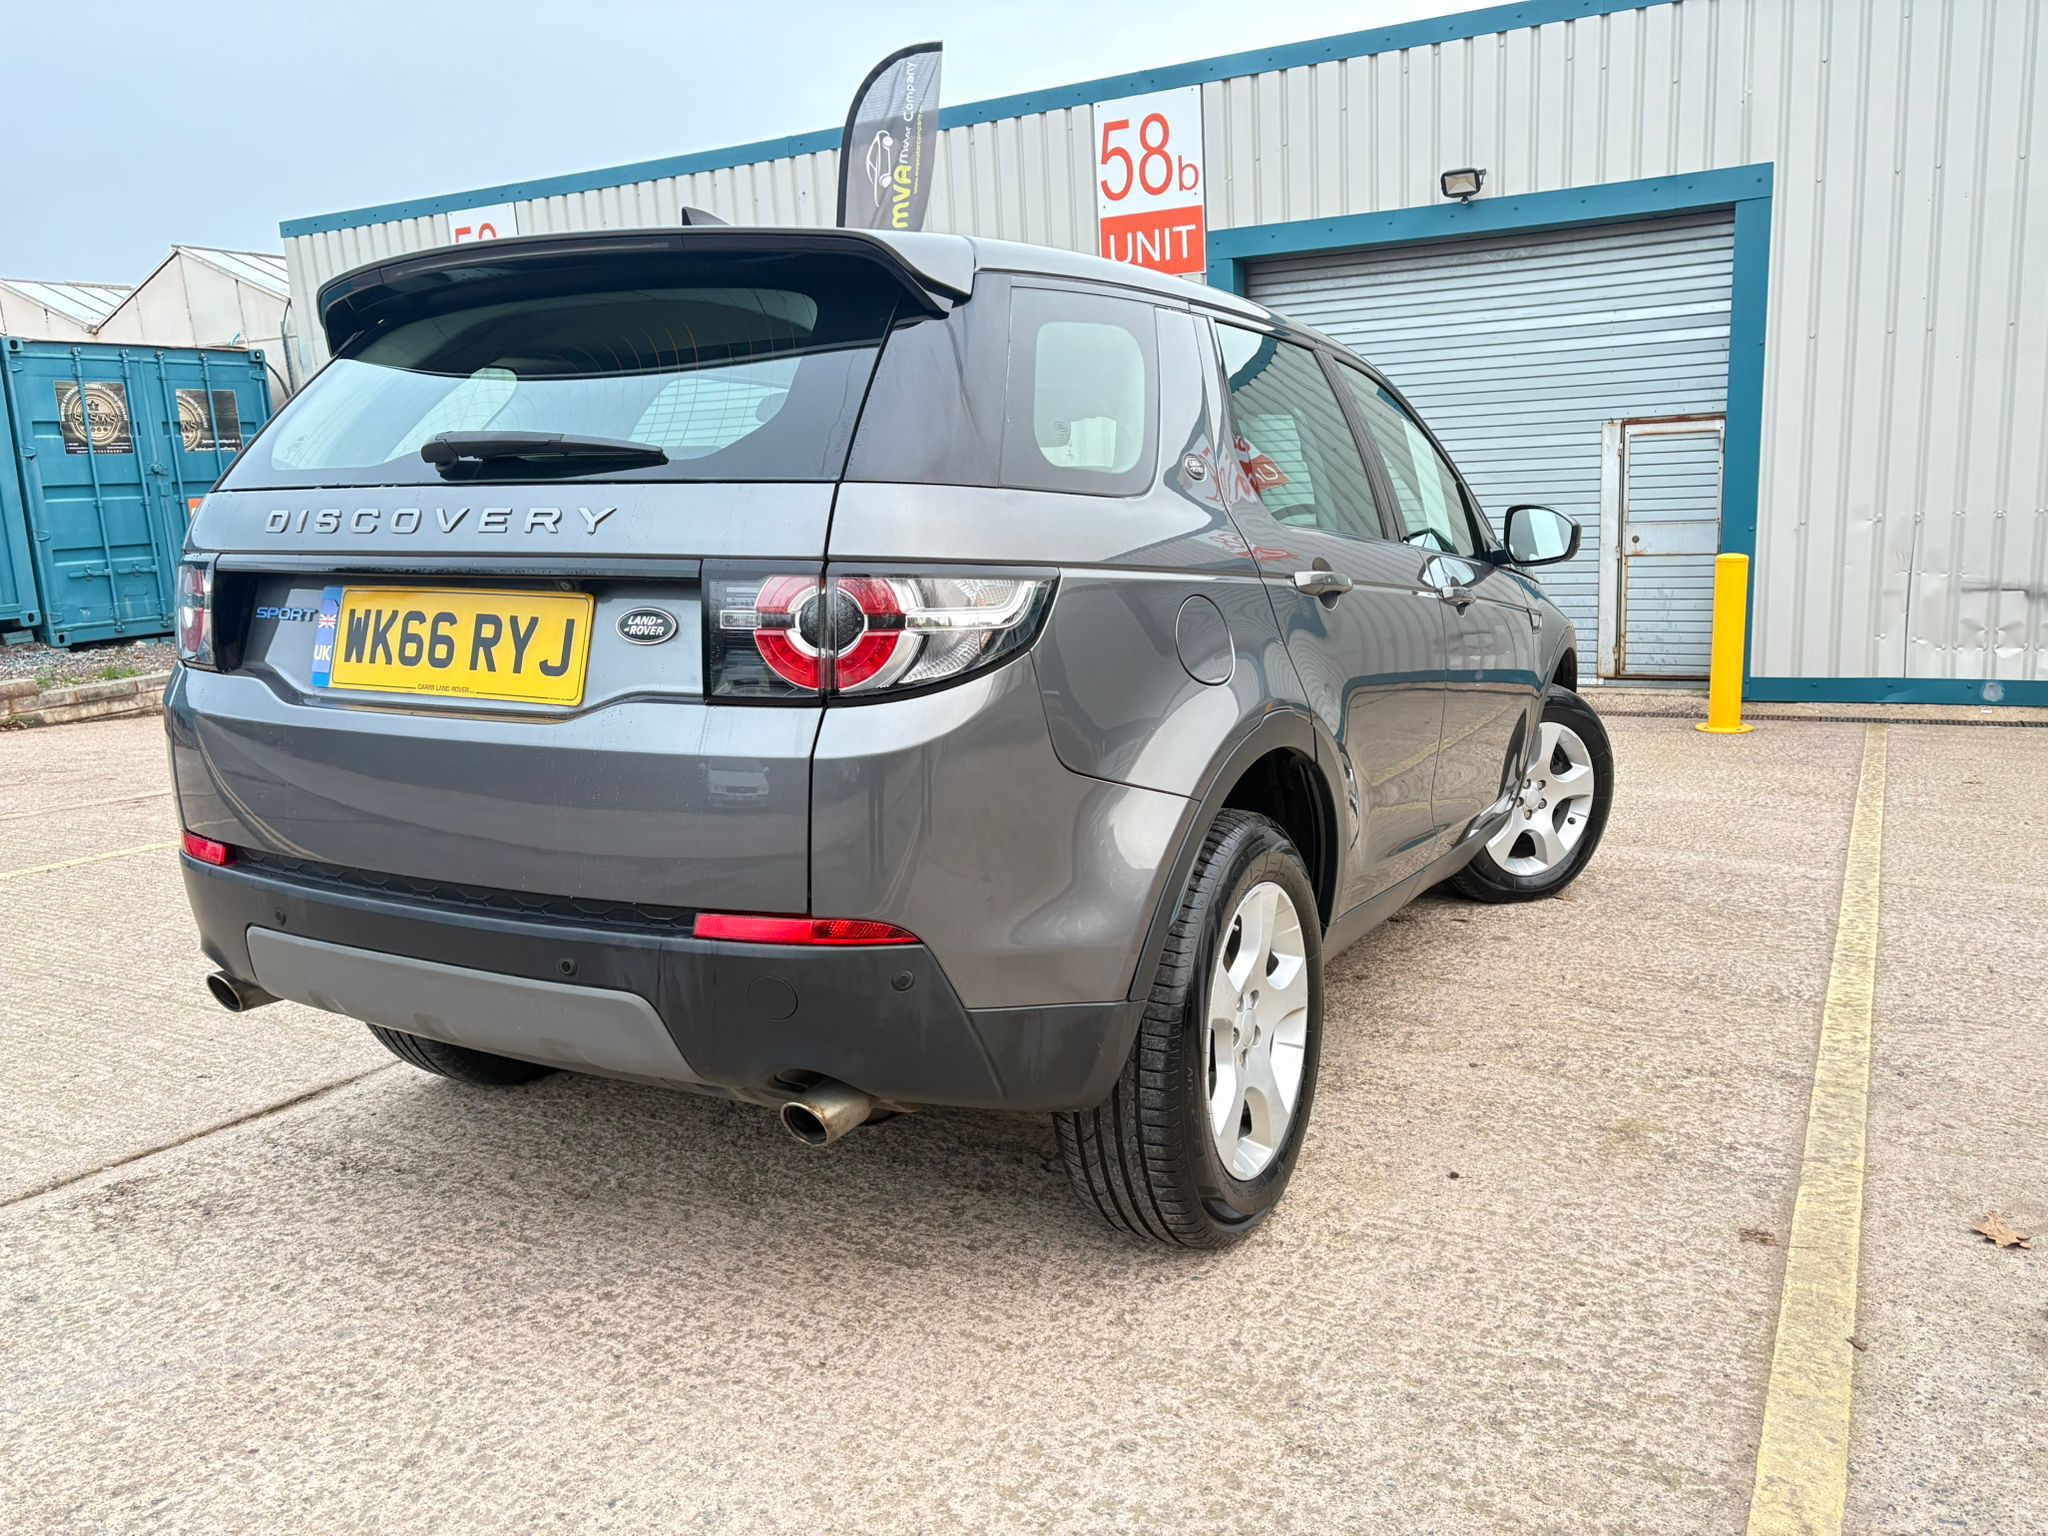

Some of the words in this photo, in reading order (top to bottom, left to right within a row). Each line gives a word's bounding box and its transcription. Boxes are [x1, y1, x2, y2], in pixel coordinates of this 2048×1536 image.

[903, 61, 917, 122] Company
[1101, 113, 1199, 201] 58b
[1109, 224, 1196, 263] UNIT
[264, 507, 617, 536] DISCOVERY
[256, 606, 316, 622] SPORT
[628, 615, 657, 625] LAND
[629, 625, 664, 636] ROVER
[313, 644, 332, 661] UK
[343, 608, 458, 669] WK66
[469, 613, 576, 677] RYJ
[451, 685, 469, 693] ROVER
